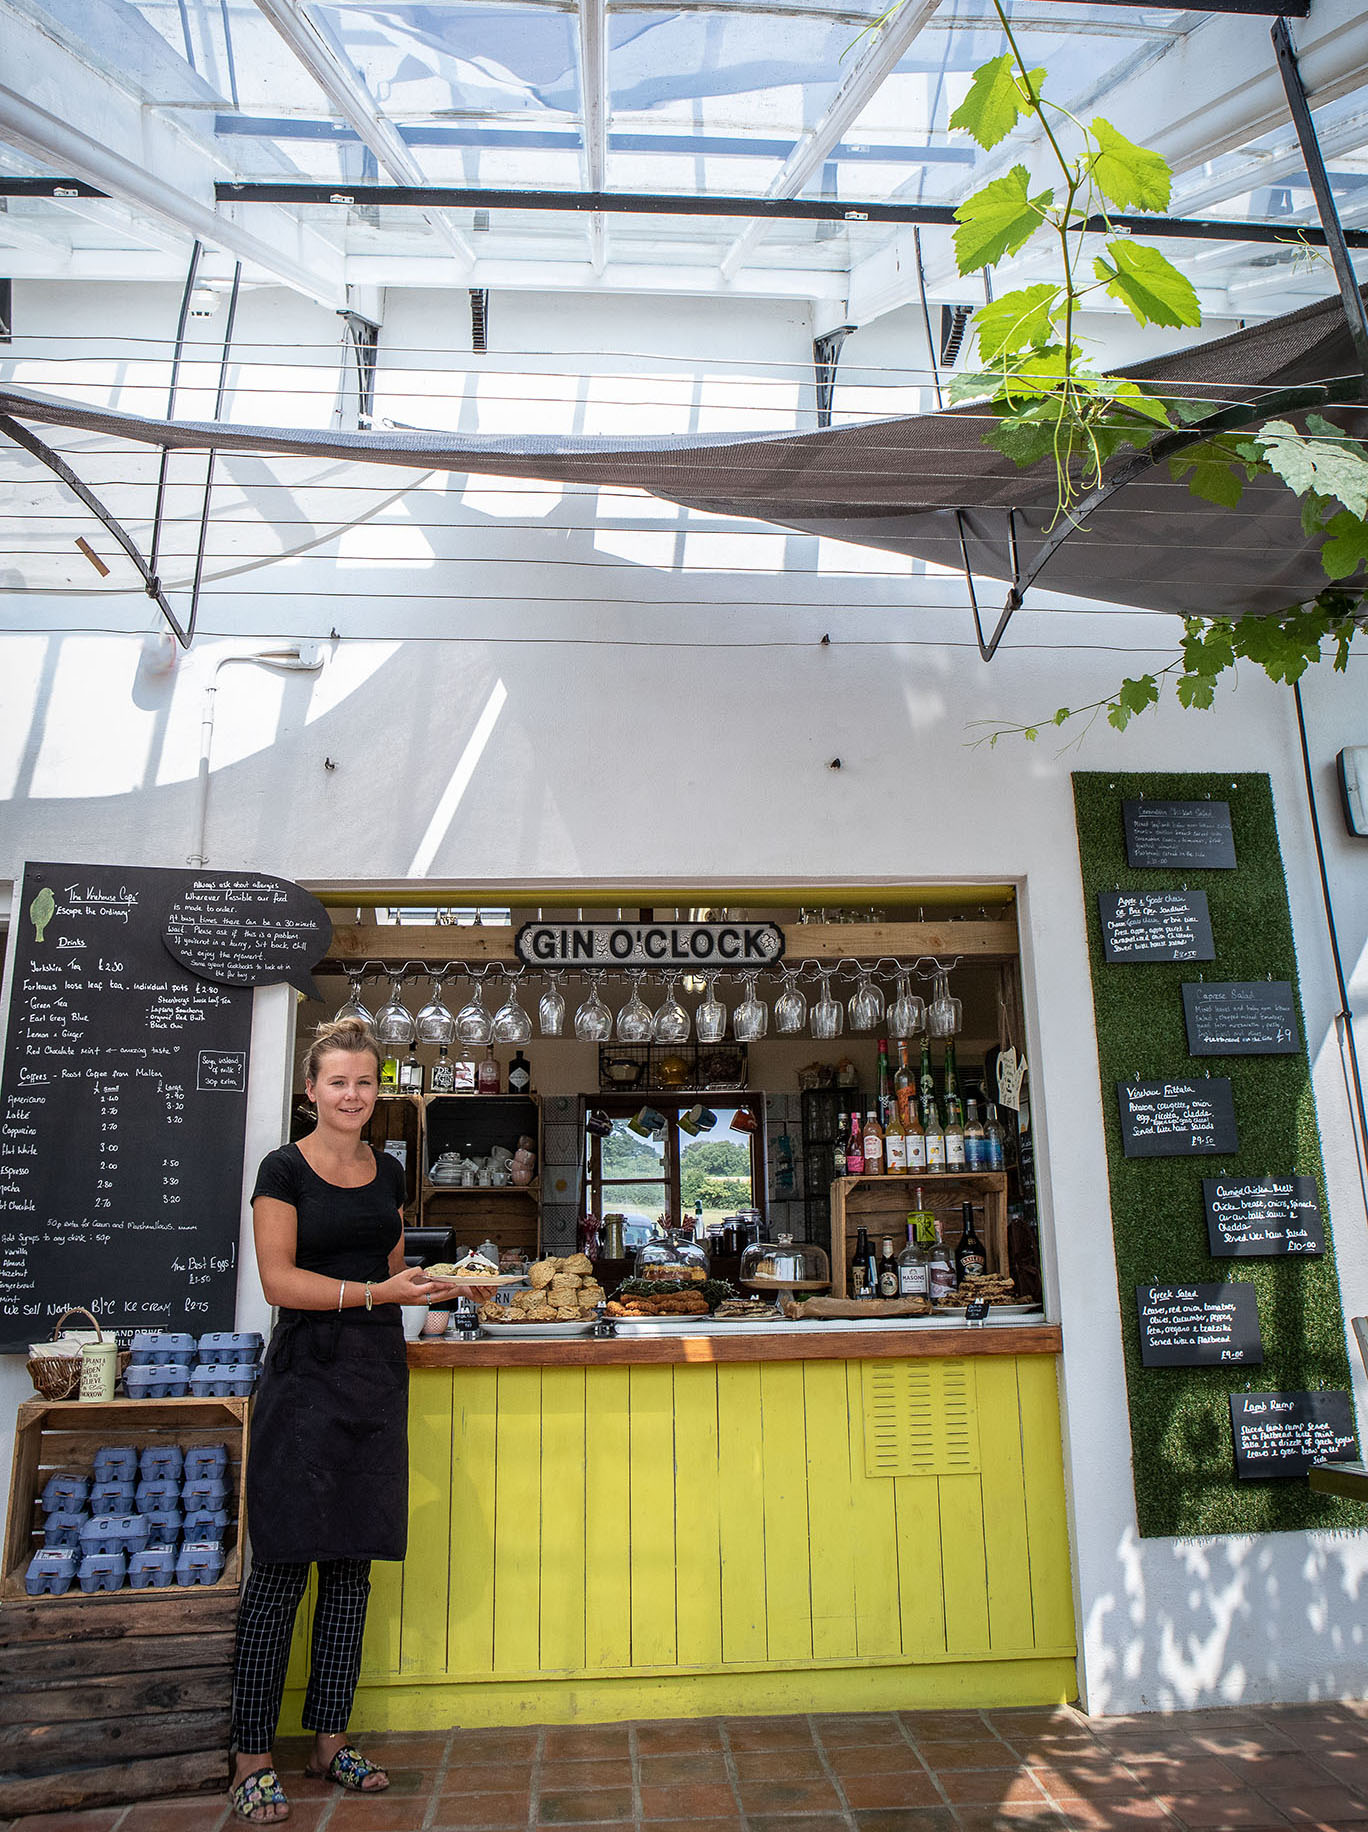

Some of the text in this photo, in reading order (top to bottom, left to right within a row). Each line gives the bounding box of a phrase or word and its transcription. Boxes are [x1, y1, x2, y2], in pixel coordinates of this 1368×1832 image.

[65, 883, 81, 901] The
[185, 892, 220, 902] Wherever
[273, 893, 288, 904] food
[85, 906, 96, 915] the
[184, 904, 203, 912] made
[181, 915, 196, 924] busy
[199, 916, 217, 924] times
[222, 917, 241, 925] there
[262, 918, 271, 926] be
[193, 926, 212, 935] Please
[244, 930, 257, 938] this
[57, 937, 87, 948] Drinks
[532, 929, 768, 959] GIN O'CLOCK
[197, 951, 216, 961] enjoy
[30, 958, 82, 972] Yorkshire Tea
[65, 980, 83, 990] loose
[87, 980, 103, 991] leaf
[133, 982, 168, 991] individual
[171, 983, 189, 993] pots
[1231, 988, 1255, 1000] Salad
[30, 996, 68, 1010] Green Tea
[29, 1012, 90, 1027] Earl Grey Blue
[150, 1021, 168, 1029] Black
[26, 1027, 84, 1043] Lemon Ginger
[1276, 1028, 1292, 1043] £9
[26, 1044, 171, 1058] Red Chocolate amazing taste
[20, 1067, 163, 1083] Coffees Roast Coffee from Malton
[7, 1095, 46, 1108] Americano
[1272, 1184, 1294, 1195] Melt
[81, 1218, 90, 1228] for
[112, 1221, 124, 1229] and
[19, 1233, 40, 1246] Syrups
[44, 1233, 50, 1241] to
[53, 1236, 65, 1246] any
[96, 1234, 111, 1245] 50p
[3, 1259, 26, 1267] Almond
[188, 1257, 207, 1270] Best
[1149, 1288, 1199, 1305] Greek Salad
[4, 1305, 19, 1315] We
[23, 1302, 41, 1315] Sell
[1169, 1306, 1182, 1314] red
[1149, 1337, 1173, 1347] Served
[1243, 1399, 1295, 1413] Lamb Rump
[1285, 1423, 1304, 1431] rump
[1304, 1438, 1313, 1447] of
